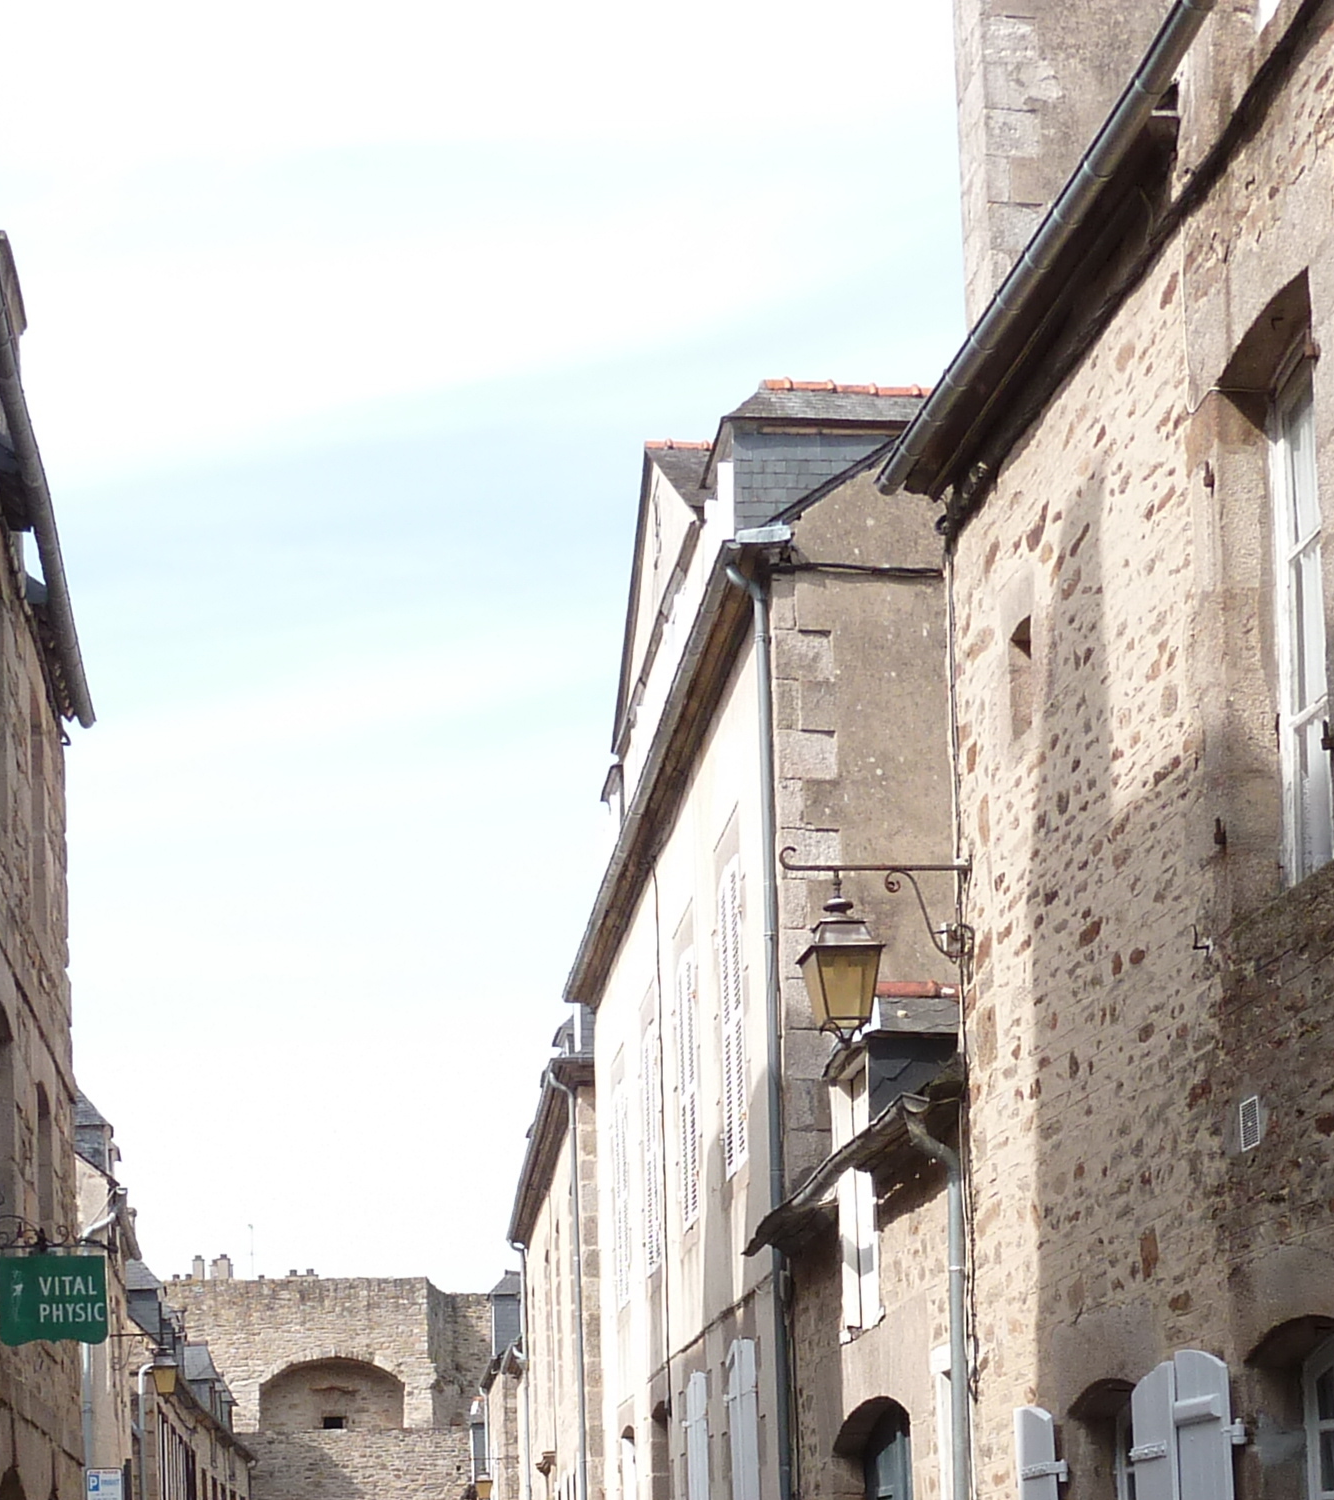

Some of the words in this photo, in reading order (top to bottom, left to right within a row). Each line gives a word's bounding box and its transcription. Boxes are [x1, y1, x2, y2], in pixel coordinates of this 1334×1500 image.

[38, 1275, 98, 1297] VITAL
[39, 1302, 105, 1323] PHYSIC
[89, 1476, 98, 1490] P
